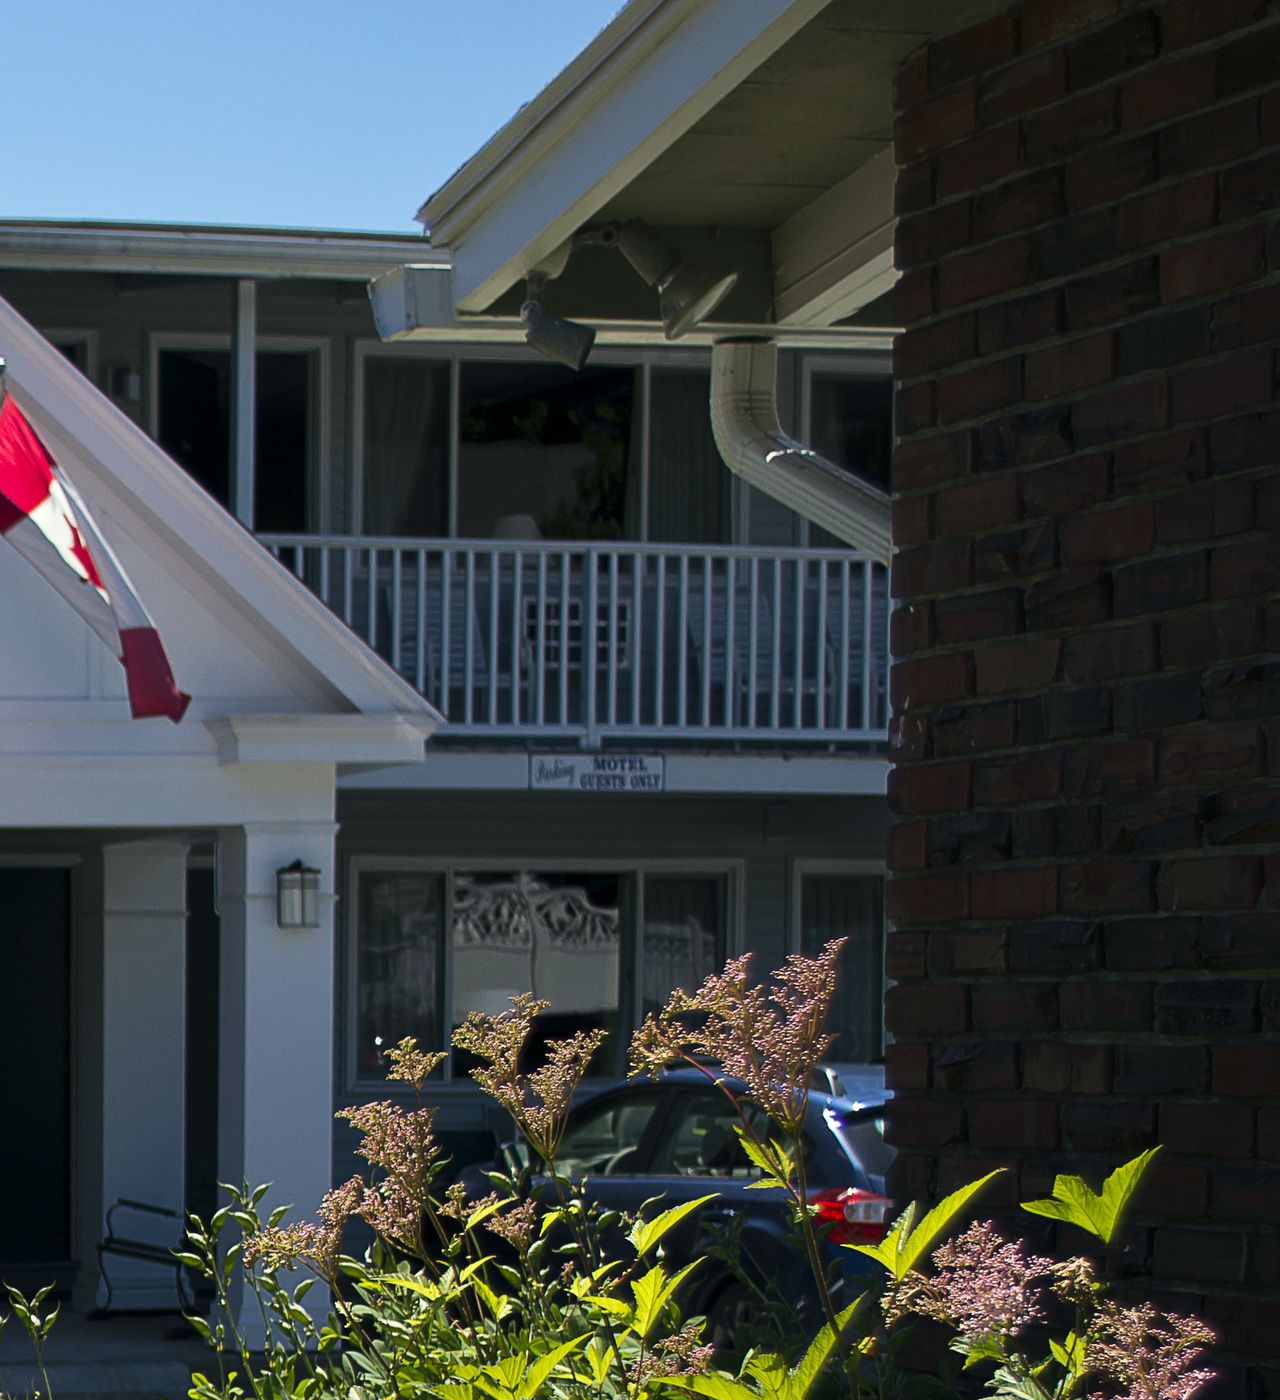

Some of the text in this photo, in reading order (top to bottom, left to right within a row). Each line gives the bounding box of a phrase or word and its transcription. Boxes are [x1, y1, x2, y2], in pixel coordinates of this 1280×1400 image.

[593, 756, 647, 771] MOTEL
[535, 758, 575, 787] Parking
[580, 774, 661, 790] GUESTS ONLY
